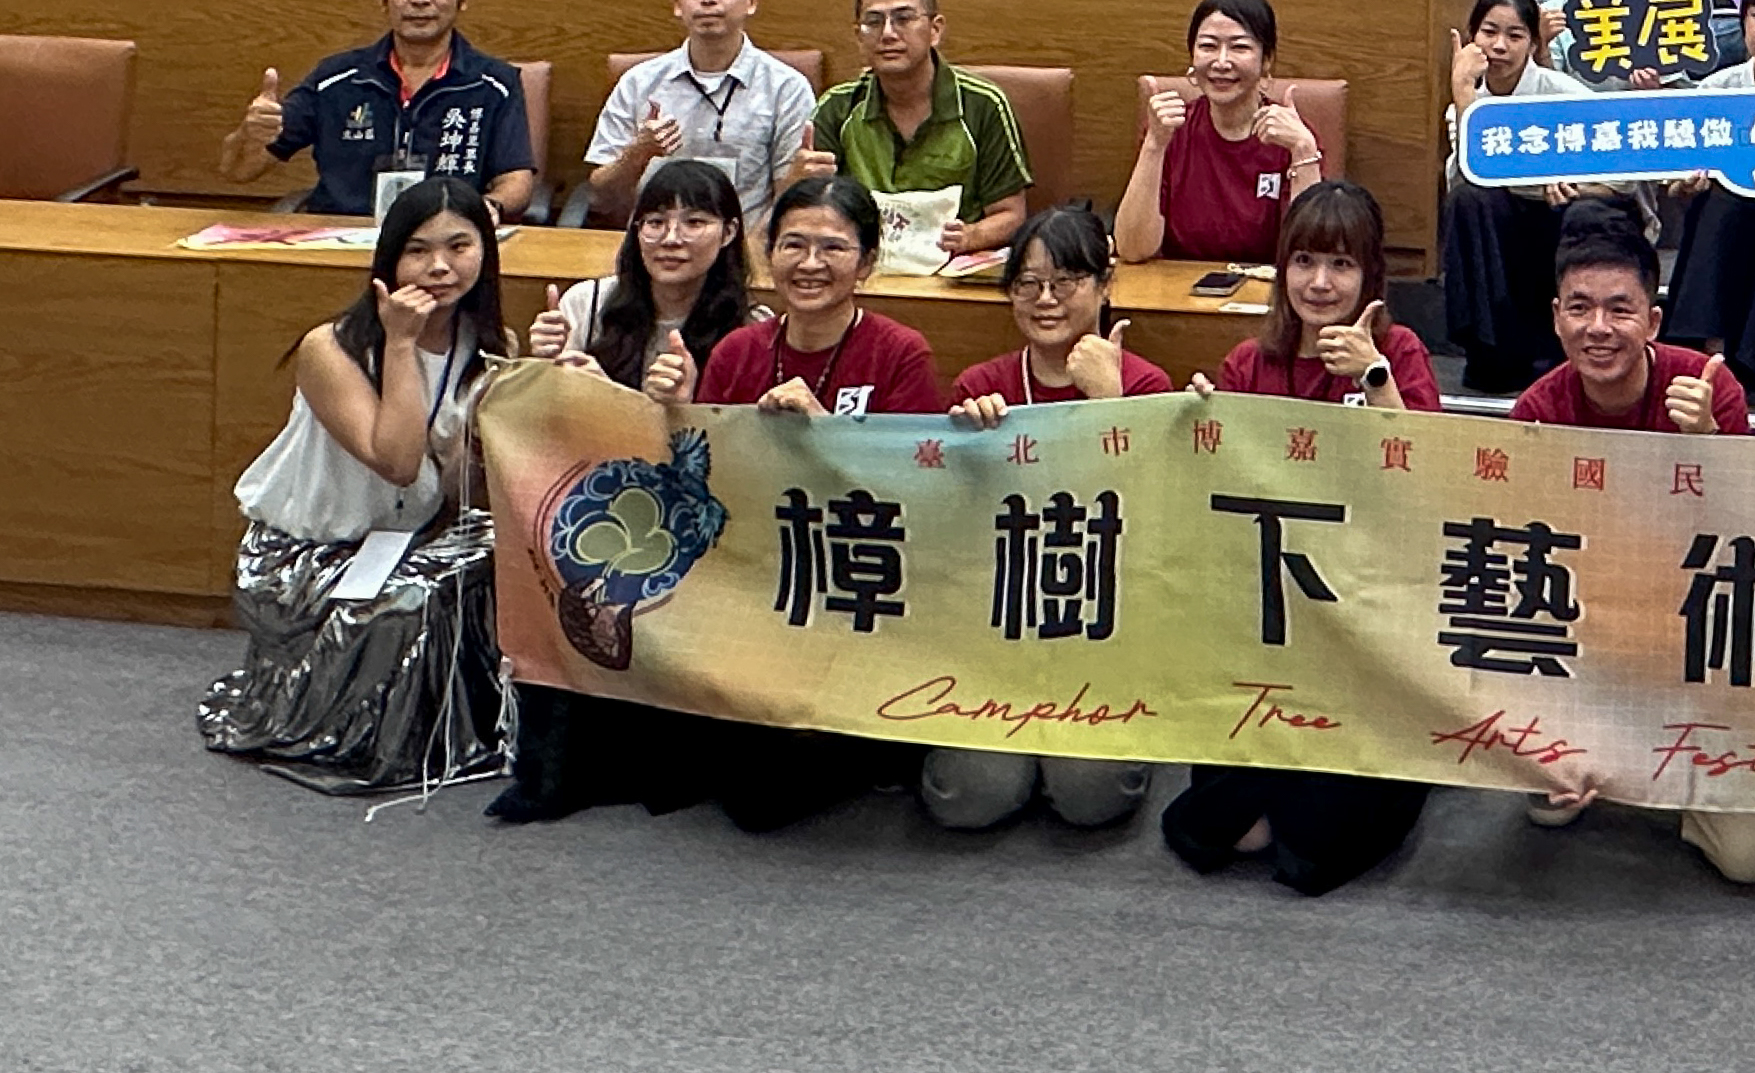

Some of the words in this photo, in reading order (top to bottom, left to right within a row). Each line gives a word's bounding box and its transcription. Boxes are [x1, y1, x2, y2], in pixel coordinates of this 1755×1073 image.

[877, 675, 1157, 738] Camphor
[1230, 681, 1340, 739] Tree
[1430, 710, 1588, 766] Arts
